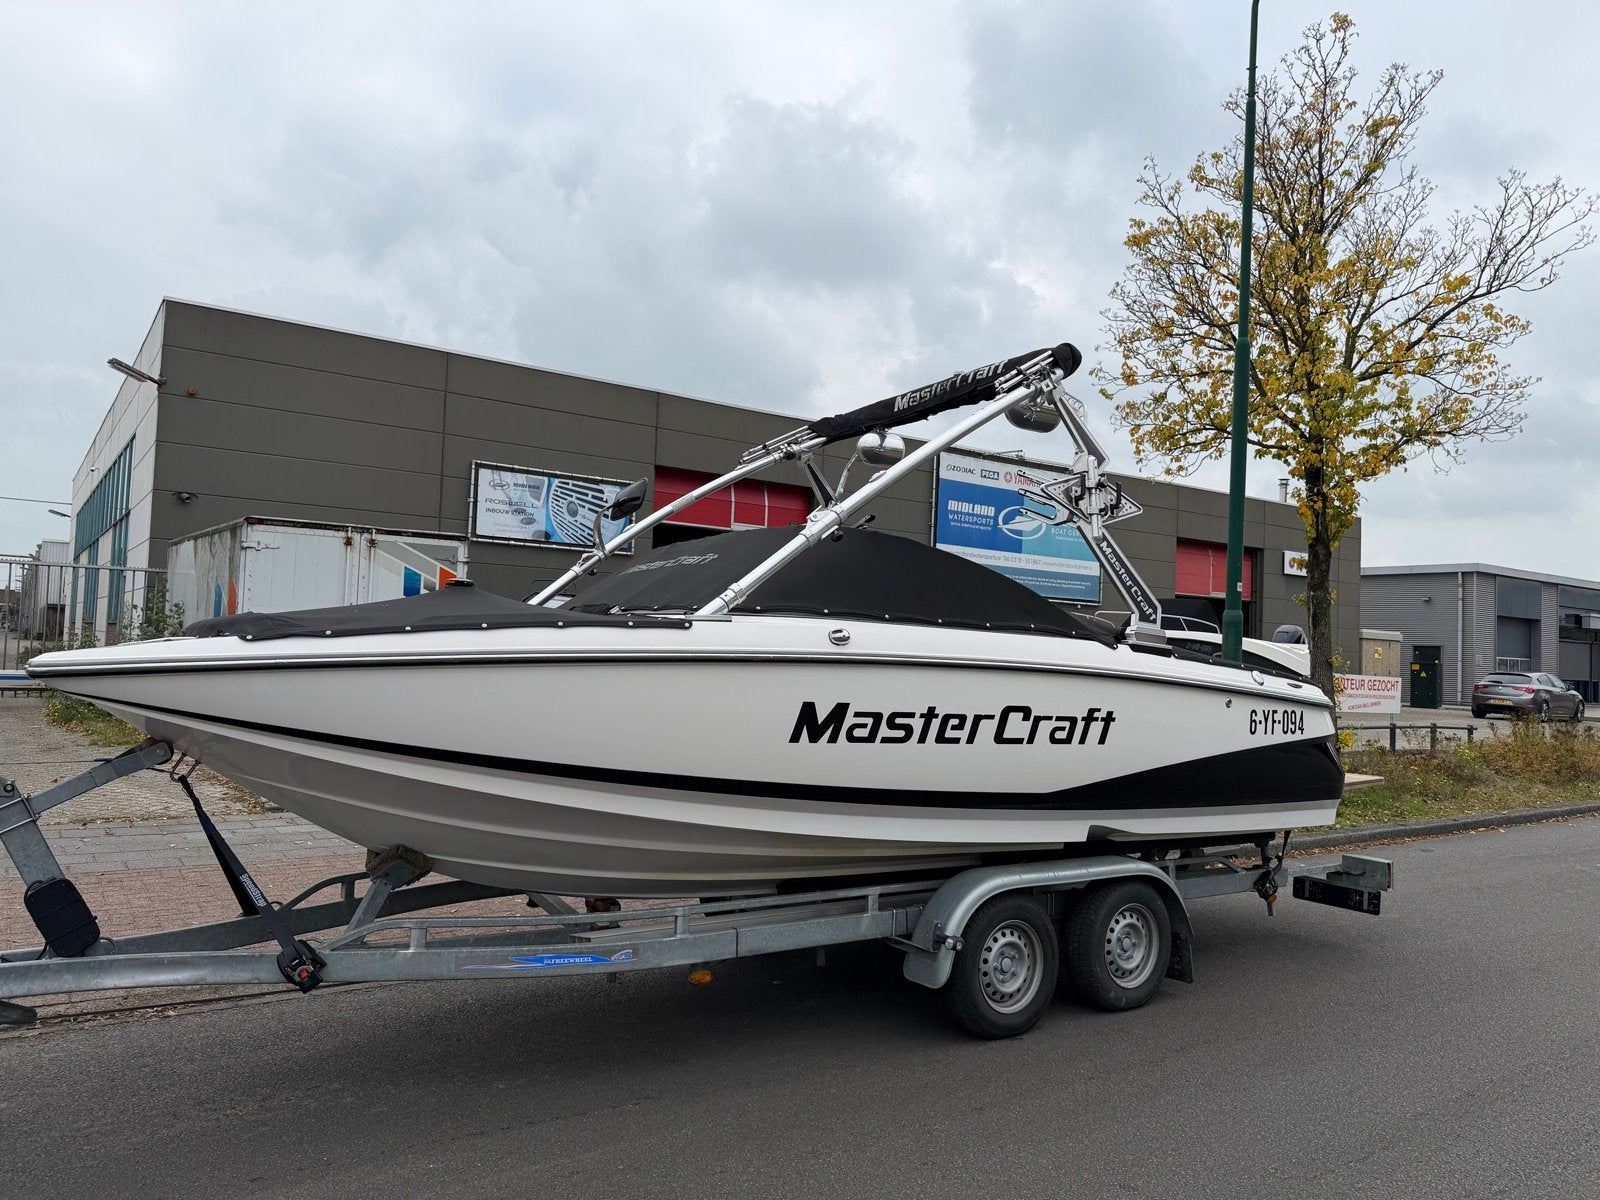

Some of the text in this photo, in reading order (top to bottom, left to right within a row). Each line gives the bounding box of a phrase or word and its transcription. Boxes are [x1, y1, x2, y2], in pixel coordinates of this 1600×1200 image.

[981, 470, 999, 480] PEGA
[1014, 472, 1040, 488] YAMA
[485, 497, 539, 509] ROSWELL
[948, 499, 996, 517] MIDLAND
[485, 507, 535, 518] INBOUW STATION
[948, 513, 994, 526] WATERSPORTS
[1100, 541, 1157, 621] MasterCraft
[1367, 679, 1399, 692] GEZOCHT
[788, 701, 1116, 745] MasterCraft
[241, 873, 267, 908] SpeedStrap
